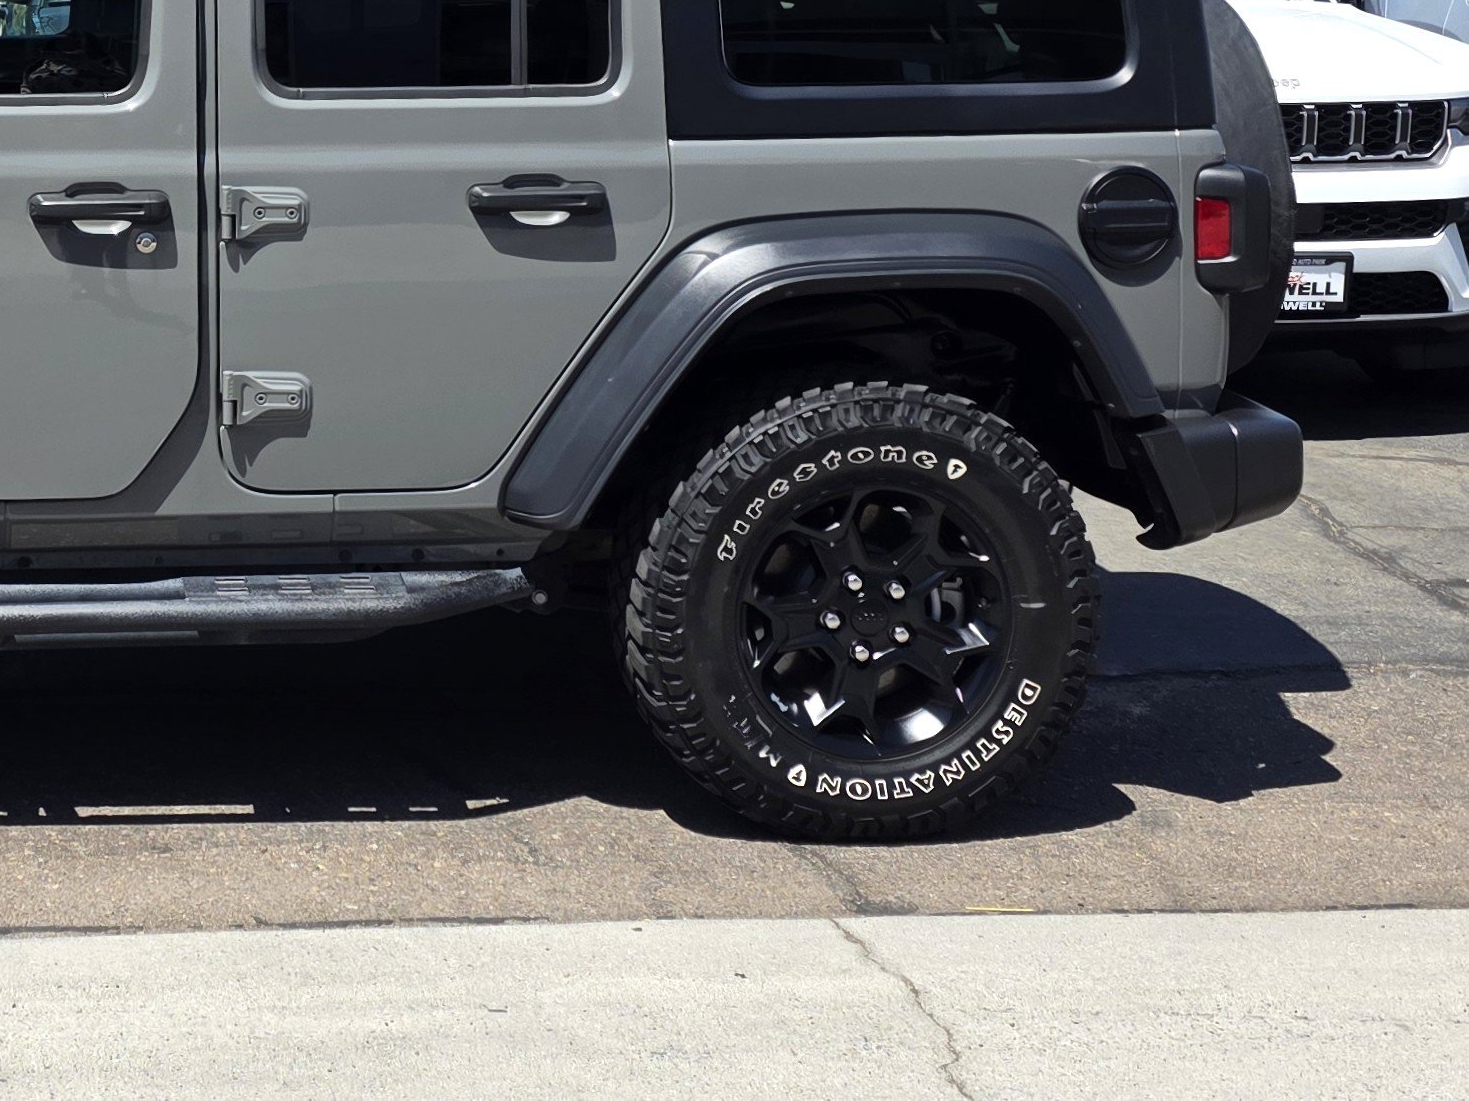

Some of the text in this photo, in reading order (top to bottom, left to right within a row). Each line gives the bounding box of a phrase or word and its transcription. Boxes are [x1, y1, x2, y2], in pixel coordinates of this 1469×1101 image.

[1280, 301, 1325, 311] WELL
[717, 445, 939, 562] Firestone
[815, 678, 1042, 800] DESTINATION
